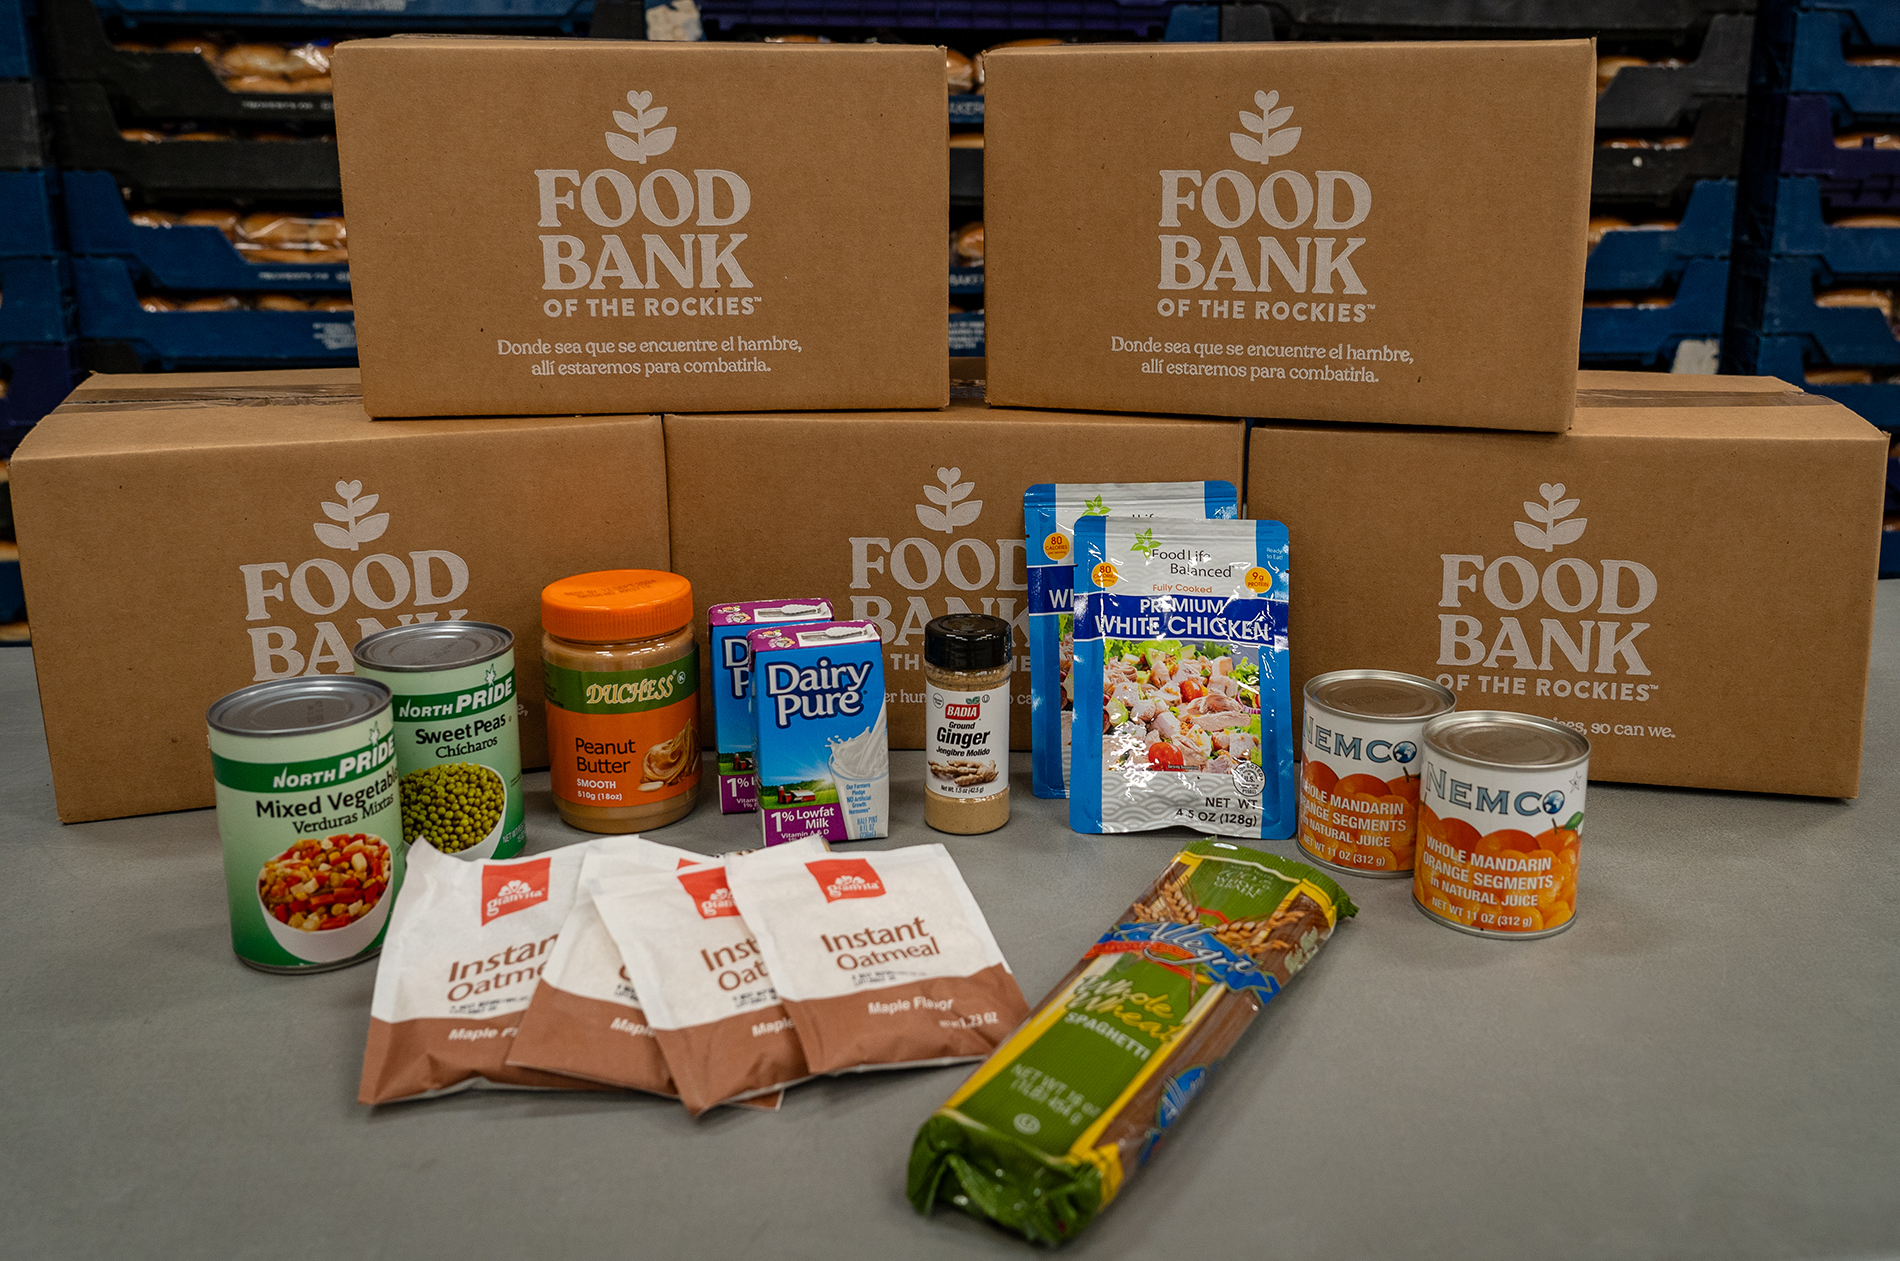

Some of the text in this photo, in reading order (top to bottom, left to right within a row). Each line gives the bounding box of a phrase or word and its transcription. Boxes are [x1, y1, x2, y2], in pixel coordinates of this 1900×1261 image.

[534, 169, 751, 227] FOOD
[1158, 169, 1372, 230] FOOD
[538, 233, 754, 290] BANK
[1157, 234, 1368, 295] BANK
[543, 299, 579, 317] OF
[586, 298, 636, 317] THE
[1157, 298, 1191, 317] OF
[1198, 299, 1246, 319] THE
[497, 336, 802, 357] Donde sea que se encuentre el hambre,
[1111, 336, 1414, 364] Donde sea que se encuentre el hambre,
[531, 357, 772, 377] allí estaremos para combatirla.
[1141, 359, 1379, 383] allí estaremos para combatirla.
[1050, 536, 1063, 545] 80
[1152, 549, 1185, 560] Food
[1099, 565, 1112, 574] 80
[1252, 572, 1264, 581] 9g
[239, 550, 469, 620] FOOD
[1152, 584, 1213, 593] Fully Cooked
[1438, 554, 1658, 614] FOOD
[1095, 615, 1269, 641] WHITE CHICKEN
[1436, 613, 1652, 676] BANK
[767, 659, 871, 695] Dairy
[1436, 674, 1470, 692] OF
[1478, 676, 1527, 695] THE
[398, 699, 454, 717] NORTH
[455, 676, 513, 713] PRIDE
[777, 691, 861, 726] Pure
[947, 706, 978, 717] BADIA
[415, 714, 506, 744] Sweet Peas
[936, 727, 991, 748] Ginger
[948, 721, 976, 730] Ground
[1591, 723, 1610, 735] so
[1614, 724, 1644, 736] can
[1648, 726, 1676, 738] we.
[435, 736, 498, 758] Chícharos
[575, 737, 636, 754] Peanut
[936, 746, 990, 757] Jengibre Molido
[273, 734, 395, 789] NORTH PRIDE
[576, 757, 631, 774] Butter
[577, 778, 616, 789] SMOOTH
[577, 790, 623, 801] 510g (18oz)
[727, 777, 749, 797] 1%
[1426, 760, 1565, 816] NEMCO
[256, 796, 321, 818] Mixed
[293, 793, 394, 834] Verduras Mixtas
[1205, 797, 1258, 809] NET WT
[1330, 794, 1404, 815] MANDARIN
[771, 807, 834, 833] 1% Lowfat
[805, 818, 829, 830] Milk
[1198, 812, 1217, 822] OZ
[1220, 813, 1257, 827] (128g)
[1332, 811, 1406, 832] SEGMENTS
[781, 830, 808, 839] Vitamin
[1309, 818, 1391, 847] NATURAL JUICE
[1303, 834, 1386, 866] NET WT 11 OZ (312 g)
[1426, 834, 1552, 872] WHOLE MANDARIN
[1423, 851, 1554, 890] ORANGE SEGMENTS
[826, 881, 880, 898] granvita
[1430, 876, 1538, 907] in NATURAL JUICE
[486, 888, 543, 917] granvita
[1432, 897, 1533, 928] NET WT 11 OZ (312 g)
[820, 916, 930, 953] Instant
[448, 933, 559, 983] Instan
[700, 938, 761, 972] Inst
[836, 937, 941, 972] Oatmeal
[447, 960, 548, 1002] Oatm
[867, 996, 954, 1015] Maple Flavor
[1074, 975, 1174, 1018] Whole
[1067, 990, 1186, 1043] Wheat
[448, 1027, 498, 1041] Maple
[1064, 1012, 1151, 1060] SPAGHETTI
